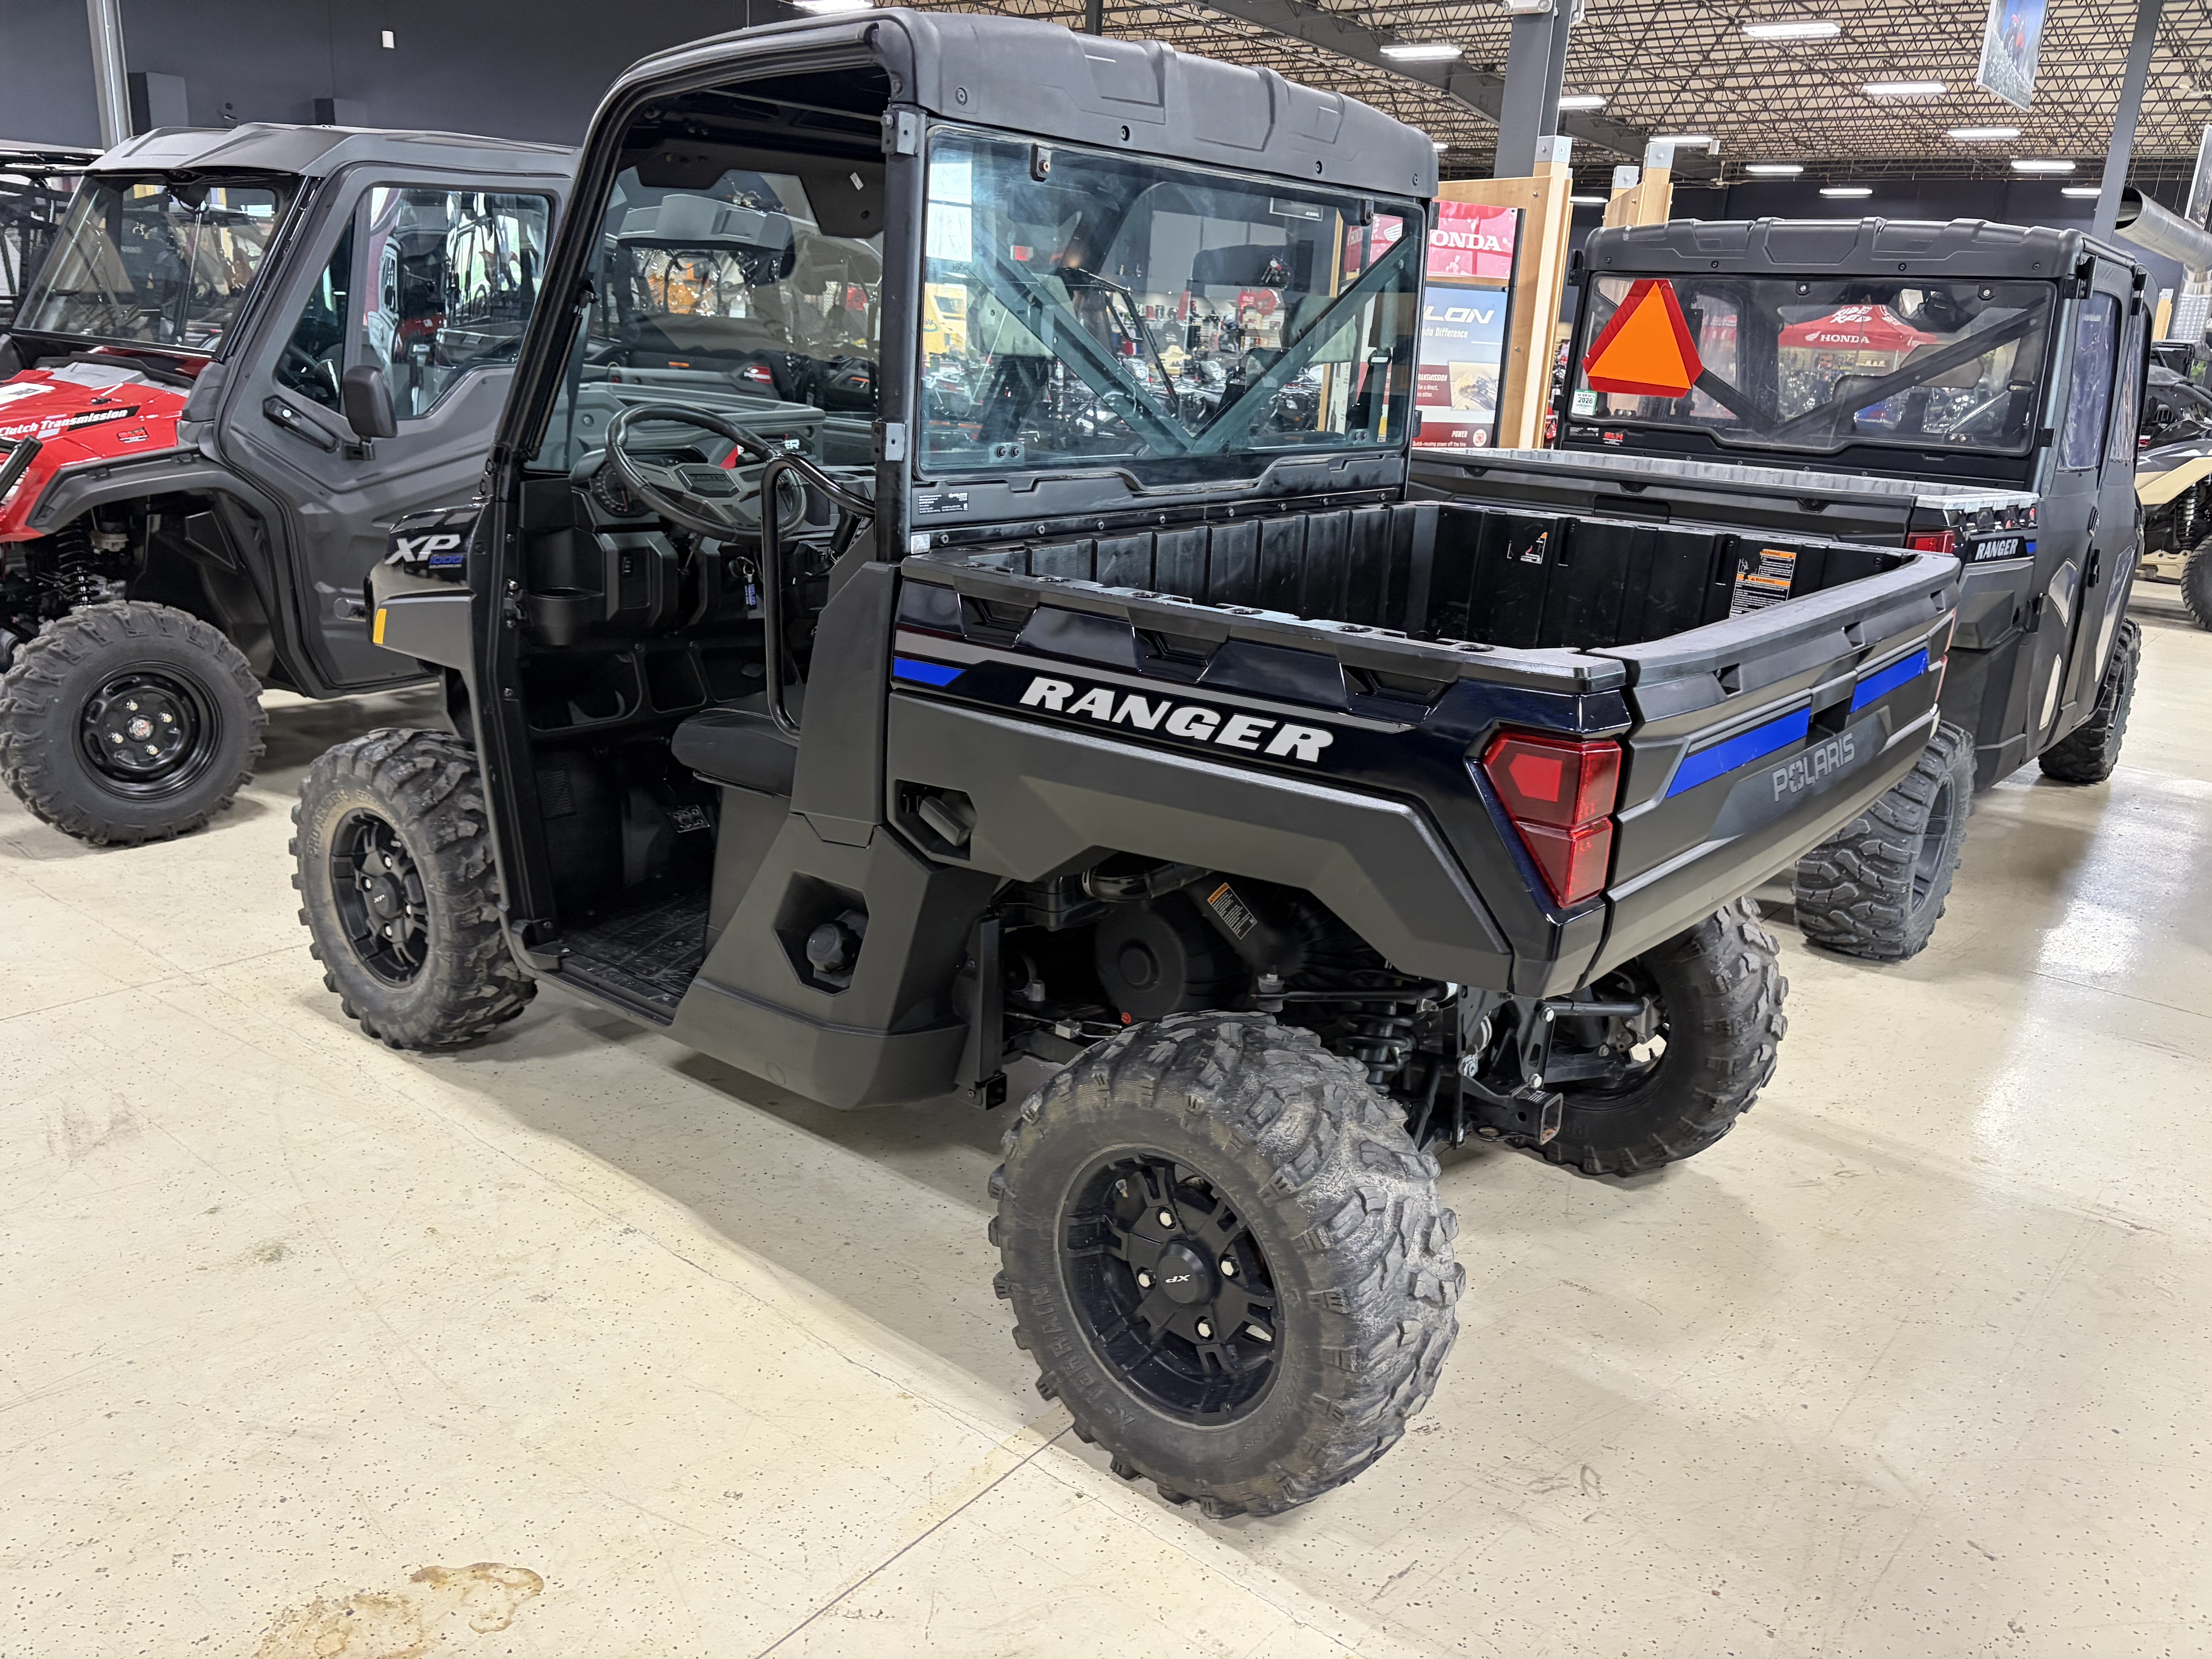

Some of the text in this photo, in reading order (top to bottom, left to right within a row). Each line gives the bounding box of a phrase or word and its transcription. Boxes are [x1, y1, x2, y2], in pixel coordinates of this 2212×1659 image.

[1431, 230, 1502, 251] ONDA
[1424, 305, 1495, 324] LON
[1435, 327, 1468, 338] Difference
[1820, 334, 1870, 344] HONDA
[1417, 373, 1448, 381] RANSMISSION
[40, 409, 128, 430] Transmission
[384, 534, 461, 565] XP
[1975, 538, 2019, 560] RANGER
[429, 555, 464, 565] 1000
[1018, 675, 1334, 763] RANGER
[1772, 732, 1855, 802] POLARIS
[1165, 1274, 1191, 1283] XP
